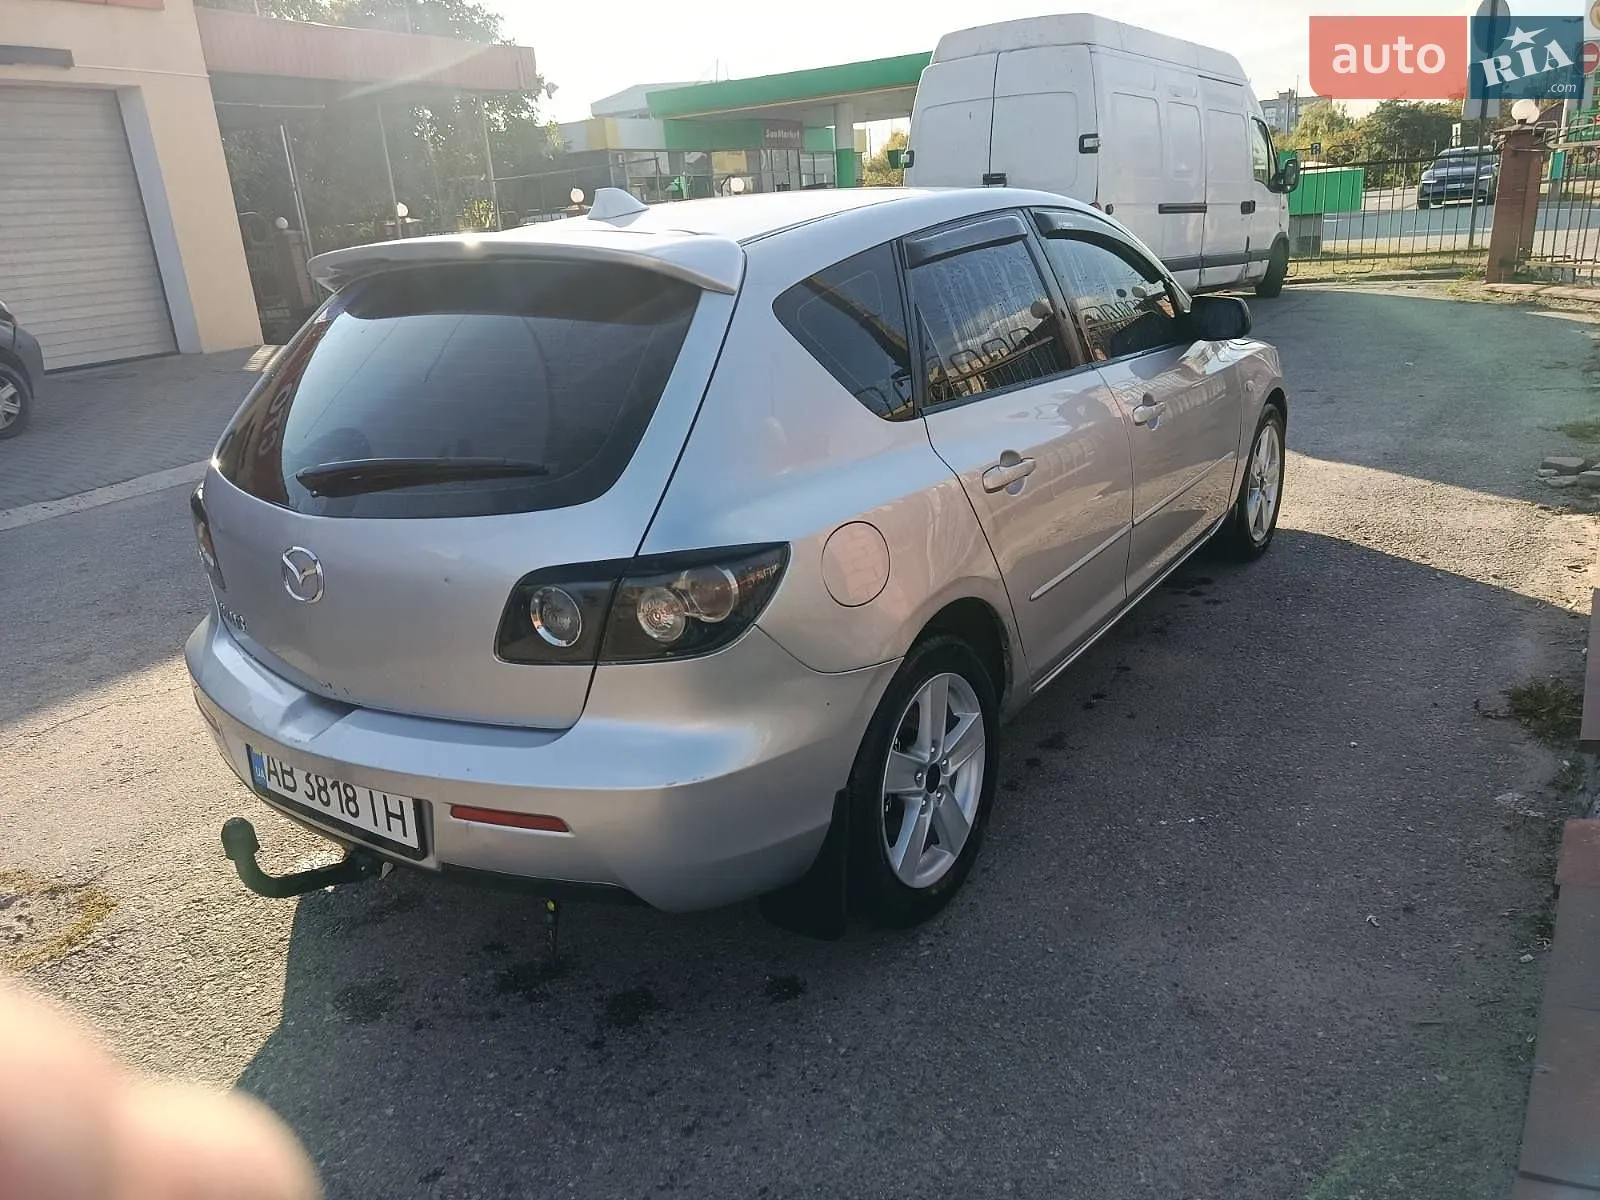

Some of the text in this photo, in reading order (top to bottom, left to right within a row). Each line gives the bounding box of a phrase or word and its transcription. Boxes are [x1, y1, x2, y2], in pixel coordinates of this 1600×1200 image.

[266, 755, 297, 793] AB
[304, 772, 360, 819] 3818
[368, 790, 408, 838] IH
